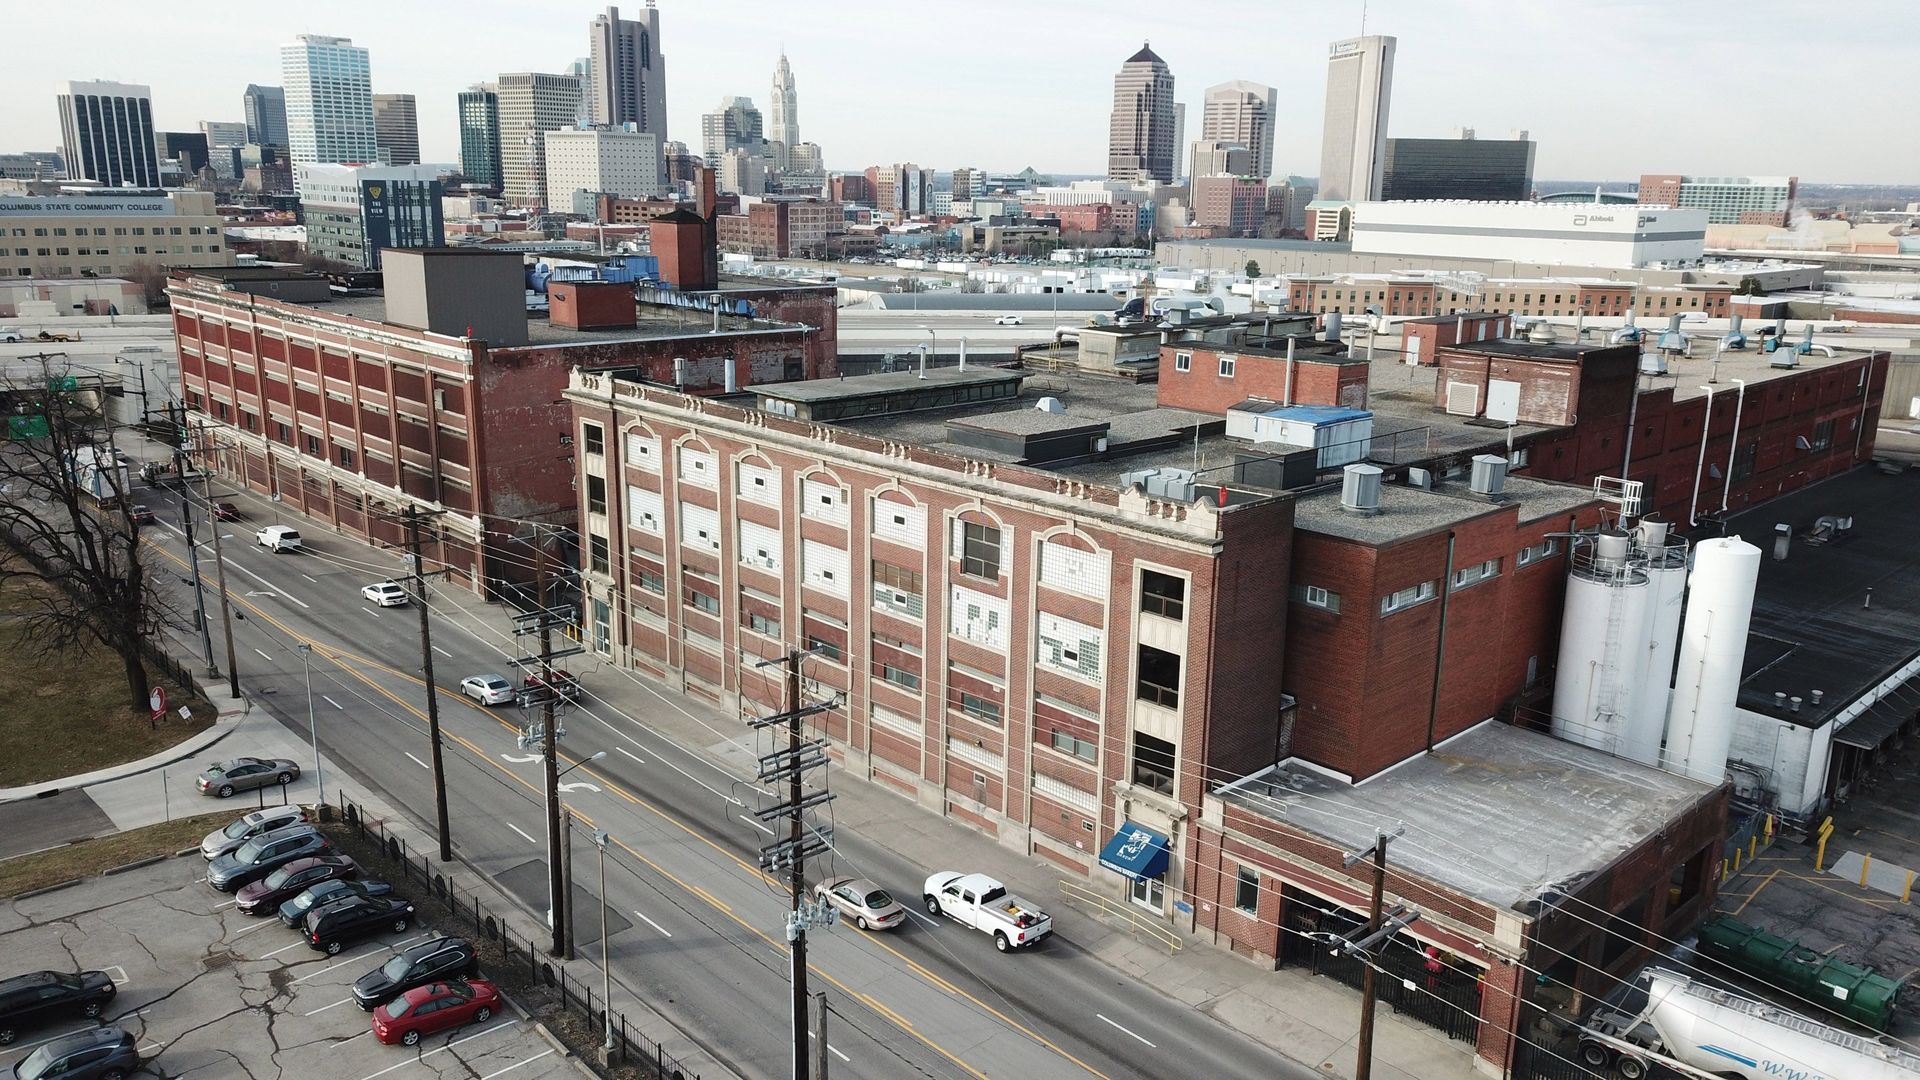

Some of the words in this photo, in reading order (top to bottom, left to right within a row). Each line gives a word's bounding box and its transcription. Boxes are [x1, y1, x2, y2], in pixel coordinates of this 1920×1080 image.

[0, 203, 42, 211] OLUMBUS
[46, 203, 71, 211] STATE
[75, 203, 124, 211] COMMUNITY
[127, 203, 163, 211] COLLEGE
